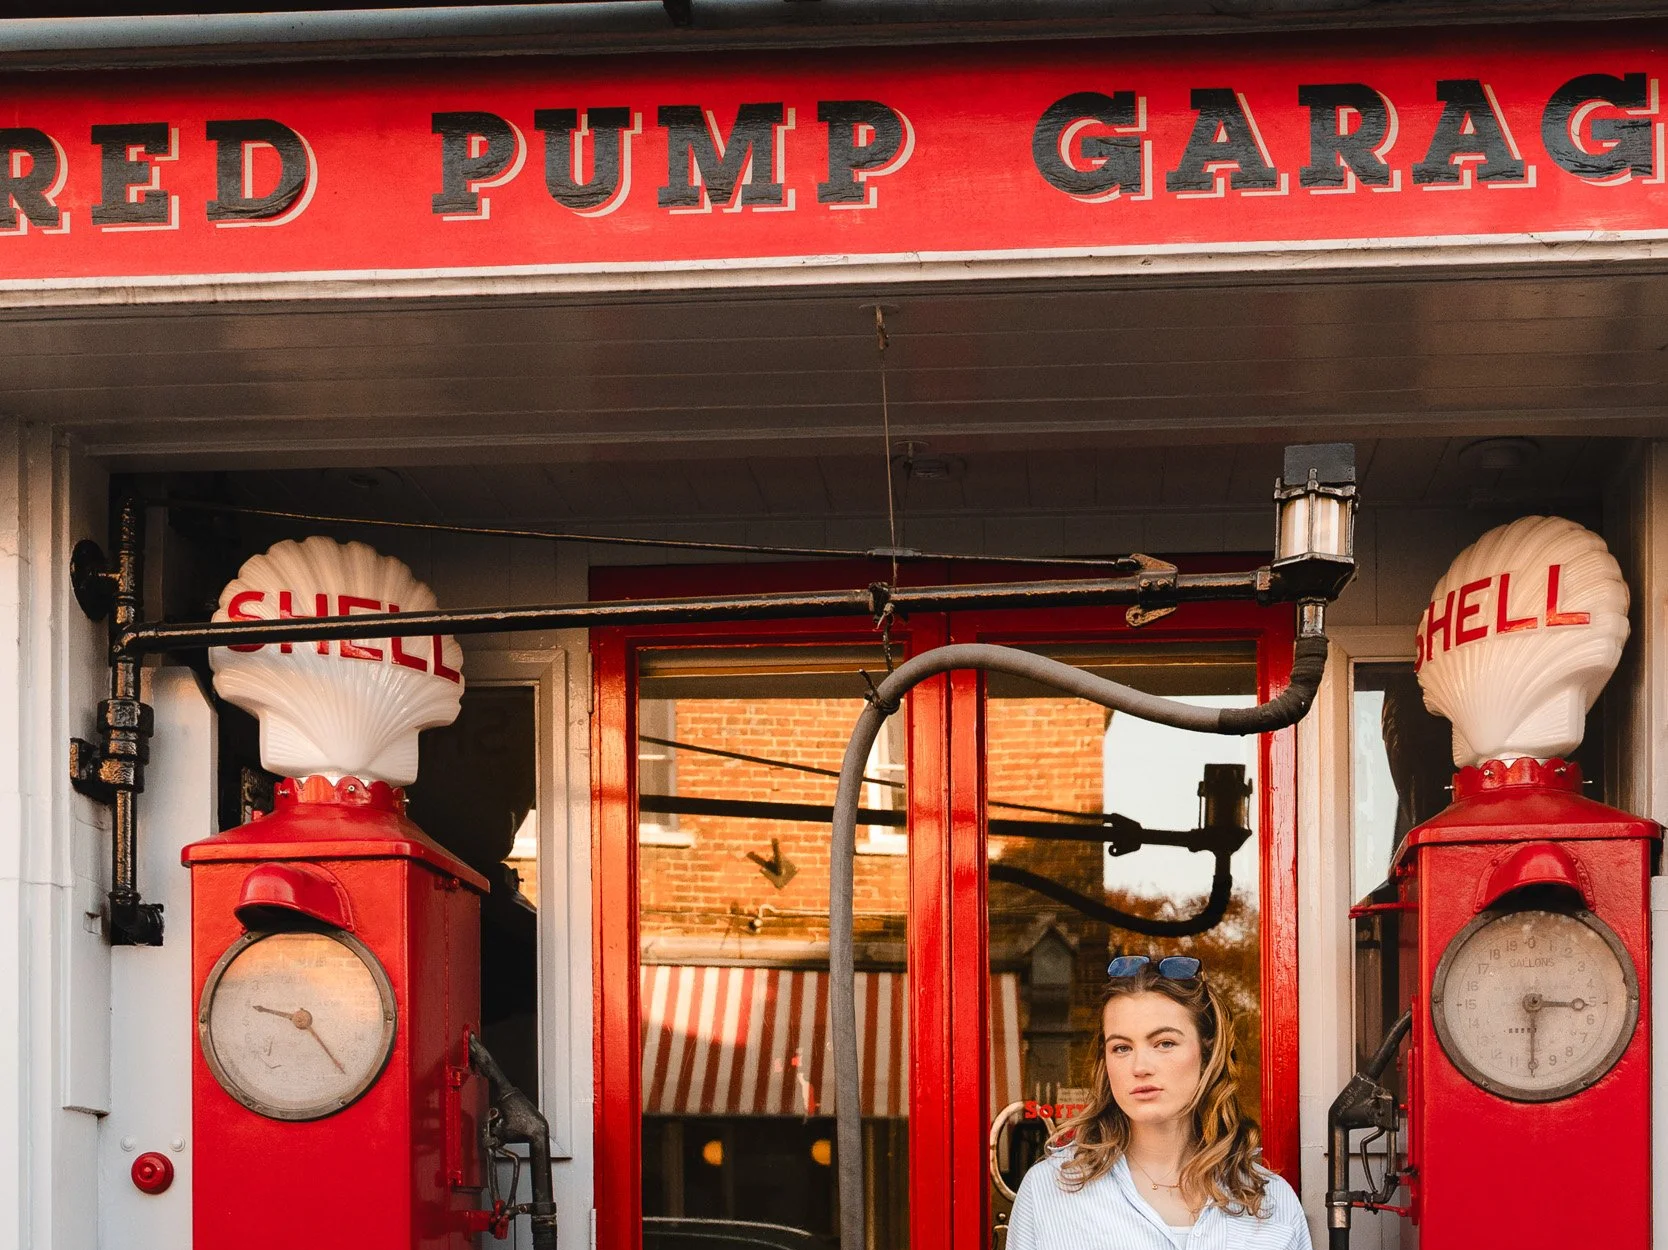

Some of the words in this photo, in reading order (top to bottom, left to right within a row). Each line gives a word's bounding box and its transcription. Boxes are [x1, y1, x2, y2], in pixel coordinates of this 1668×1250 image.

[0, 119, 318, 235] RED
[432, 100, 916, 221] PUMP
[1032, 73, 1665, 203] GARAG
[227, 590, 461, 684] SHELL
[1489, 949, 1501, 960] 18
[1565, 947, 1573, 958] 2
[1509, 957, 1555, 968] GALLONS
[1577, 961, 1586, 972] 3
[1478, 963, 1489, 975] 17
[1467, 981, 1479, 992] 16
[1587, 978, 1594, 989] 4
[1465, 999, 1477, 1010] 15
[1586, 1014, 1595, 1025] 6
[1579, 1032, 1588, 1043] 7
[1565, 1046, 1574, 1057] 8
[1549, 1055, 1557, 1066] 9
